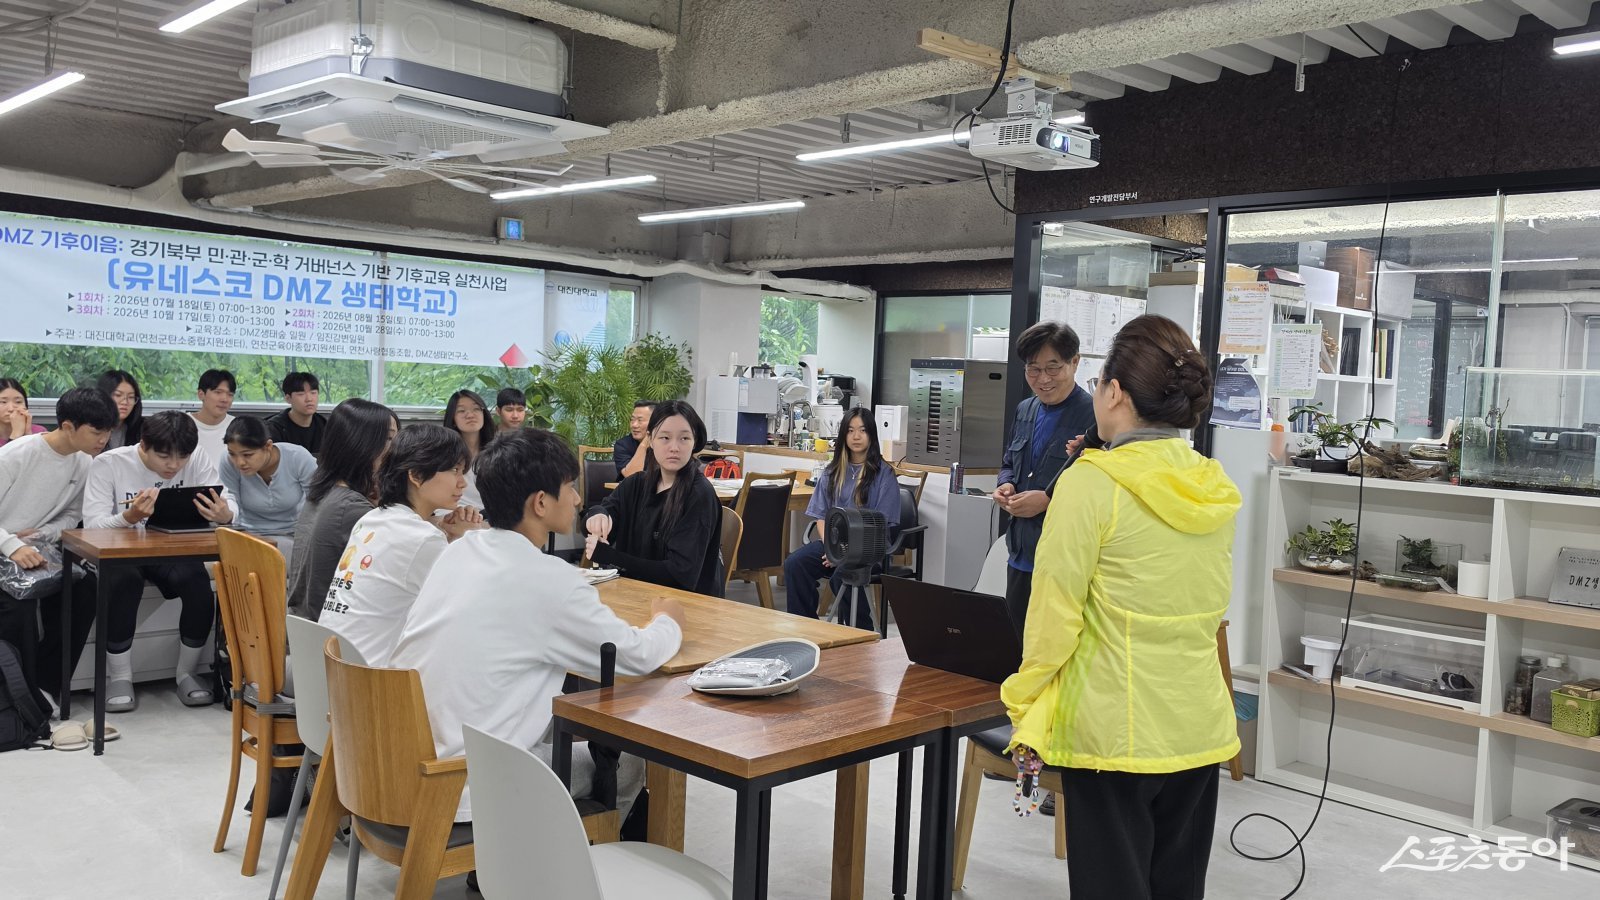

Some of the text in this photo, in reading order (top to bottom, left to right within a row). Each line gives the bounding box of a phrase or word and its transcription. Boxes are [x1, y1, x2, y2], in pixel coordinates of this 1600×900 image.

[1089, 191, 1138, 204] 연구개발전담부서
[0, 226, 508, 292] MZ 기후이음: 경기북부 민·관·군·학 거버넌스 기반 기후교육 실천사업
[108, 258, 458, 317] (유네스코 DMZ 생태학교)
[557, 285, 598, 297] 대진대학교
[77, 292, 104, 304] 1회차
[114, 294, 149, 307] 2026년
[152, 298, 175, 309] 07월
[178, 300, 216, 312] 18일(토)
[76, 304, 104, 316] 3회차
[113, 307, 149, 319] 2026년
[152, 310, 175, 321] 10월
[178, 311, 216, 323] 17일(토)
[292, 308, 315, 318] 2회차
[323, 310, 352, 322] 2026년
[354, 313, 373, 323] 08월
[375, 314, 407, 326] 15일(토)
[54, 328, 75, 340] 주관
[194, 324, 231, 337] 교육장소
[240, 327, 287, 340] DMZ생태숲
[289, 330, 306, 341] 일원
[291, 319, 315, 329] 4회차
[322, 321, 352, 333] 2026년
[355, 325, 373, 334] 10월
[375, 325, 407, 337] 28일(수)
